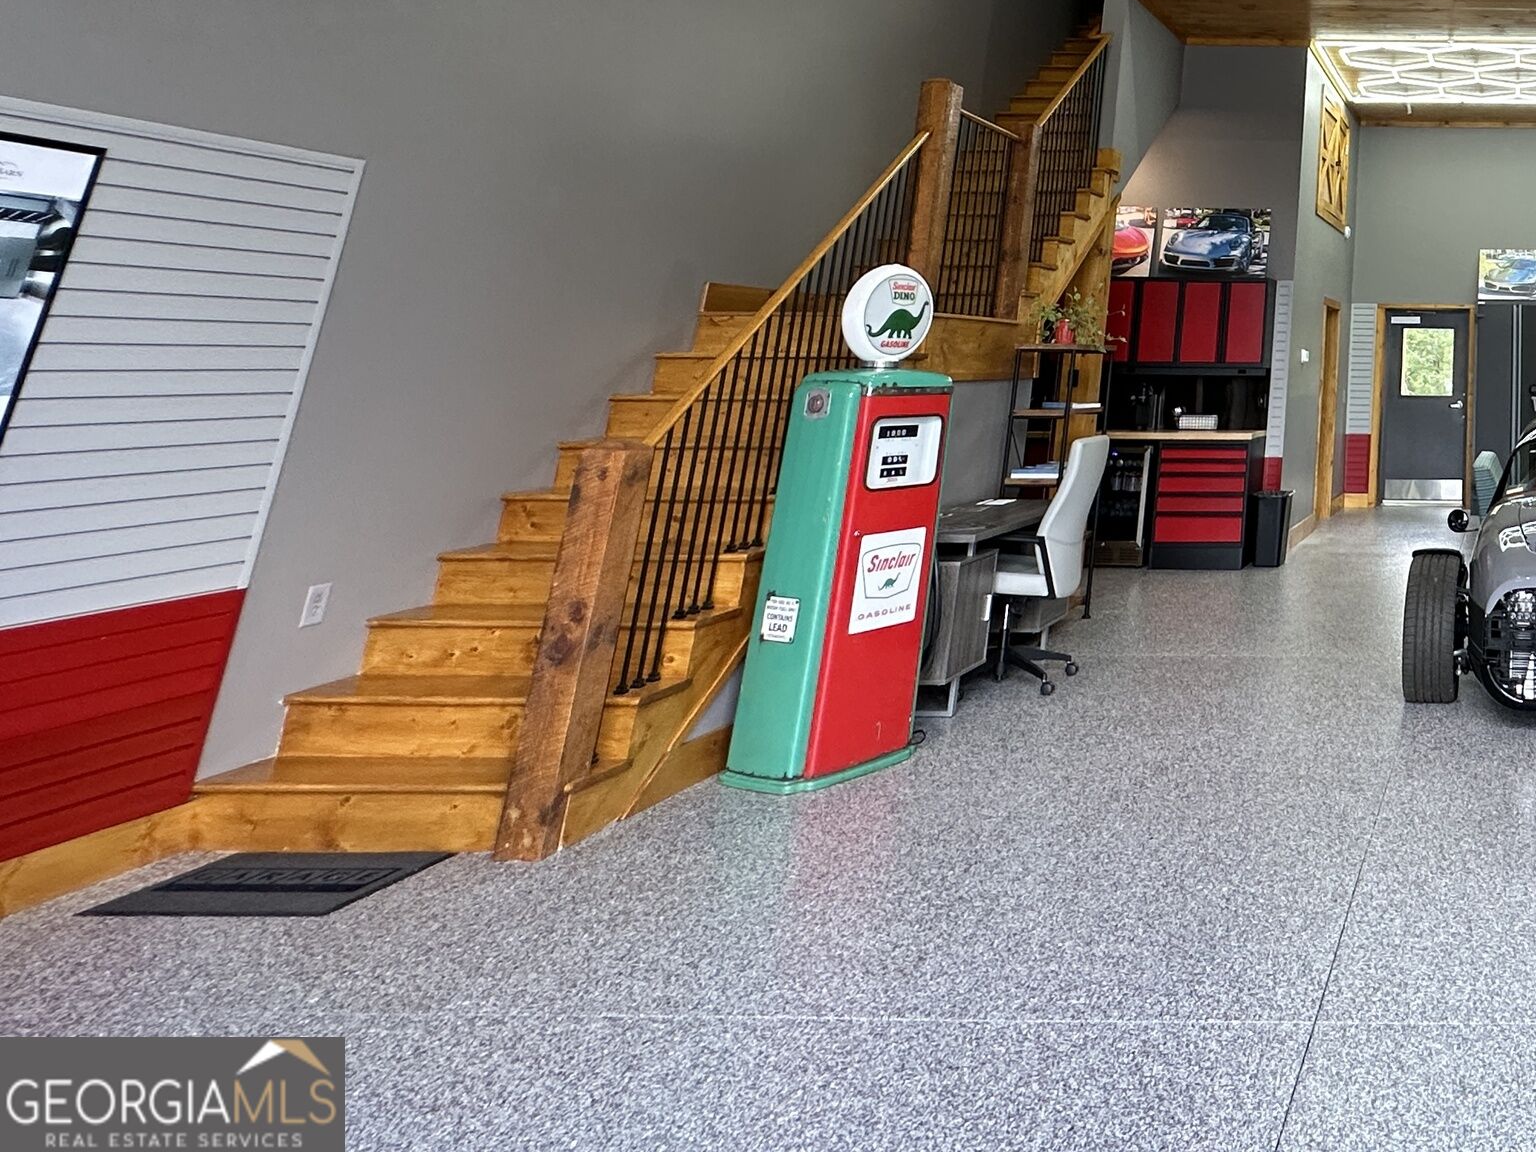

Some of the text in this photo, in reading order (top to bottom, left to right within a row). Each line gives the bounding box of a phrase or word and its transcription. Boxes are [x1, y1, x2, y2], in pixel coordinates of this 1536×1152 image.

[894, 292, 915, 301] DINO
[881, 340, 909, 348] GASOLINE
[867, 551, 916, 573] Sinclair
[858, 604, 911, 620] GASOLINE
[769, 623, 788, 632] LEAD
[193, 871, 381, 882] GARAGE
